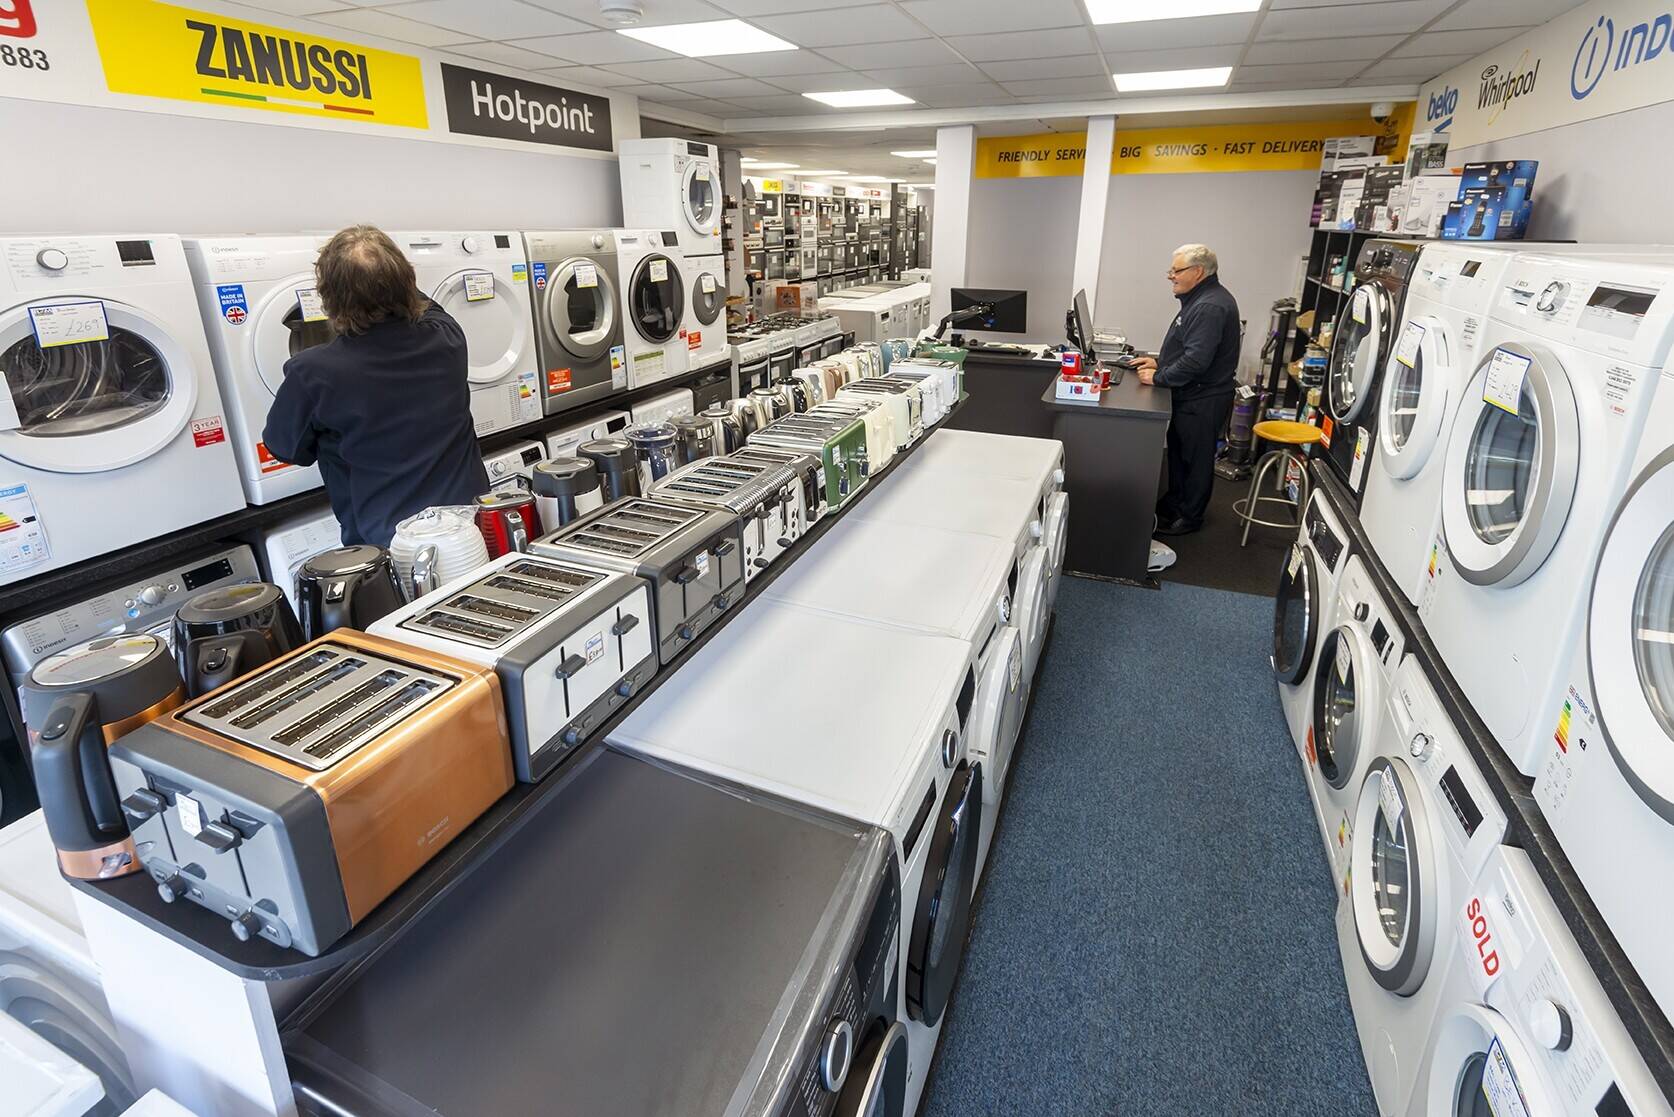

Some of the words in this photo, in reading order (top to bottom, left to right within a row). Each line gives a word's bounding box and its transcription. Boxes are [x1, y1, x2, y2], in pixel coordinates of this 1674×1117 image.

[0, 44, 50, 71] 883
[186, 19, 372, 100] ZANUSSI
[1427, 87, 1458, 122] beko
[1477, 59, 1541, 110] Whirlpool
[471, 80, 595, 134] Hotpoint
[998, 150, 1050, 162] FRIENDLY
[1119, 146, 1142, 158] BIG
[1154, 144, 1208, 157] SAVINGS
[1223, 142, 1256, 155] FAST
[1262, 140, 1326, 154] DELIVERY
[194, 423, 201, 432] 3
[1467, 898, 1500, 977] SOLD
